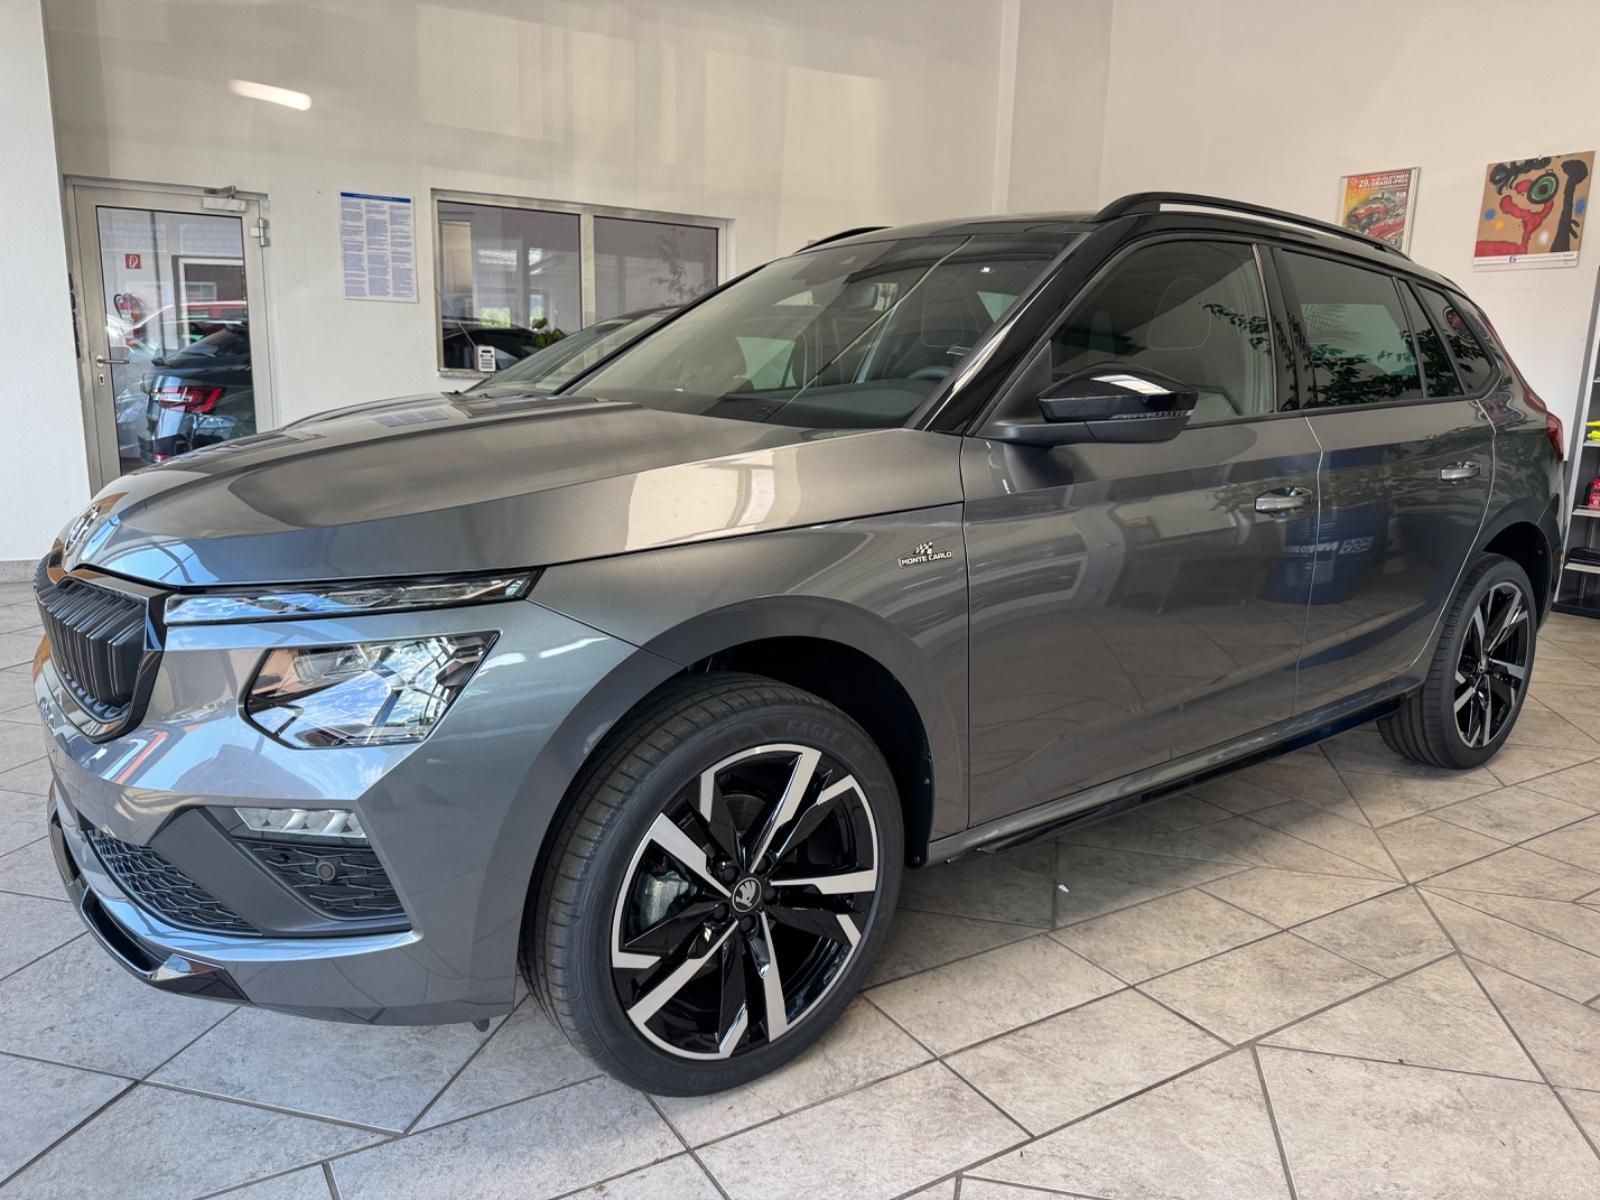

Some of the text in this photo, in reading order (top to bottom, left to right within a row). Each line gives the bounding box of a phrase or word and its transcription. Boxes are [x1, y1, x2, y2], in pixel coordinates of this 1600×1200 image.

[901, 551, 952, 565] MONTE CARLO
[786, 719, 842, 743] EAGLE
